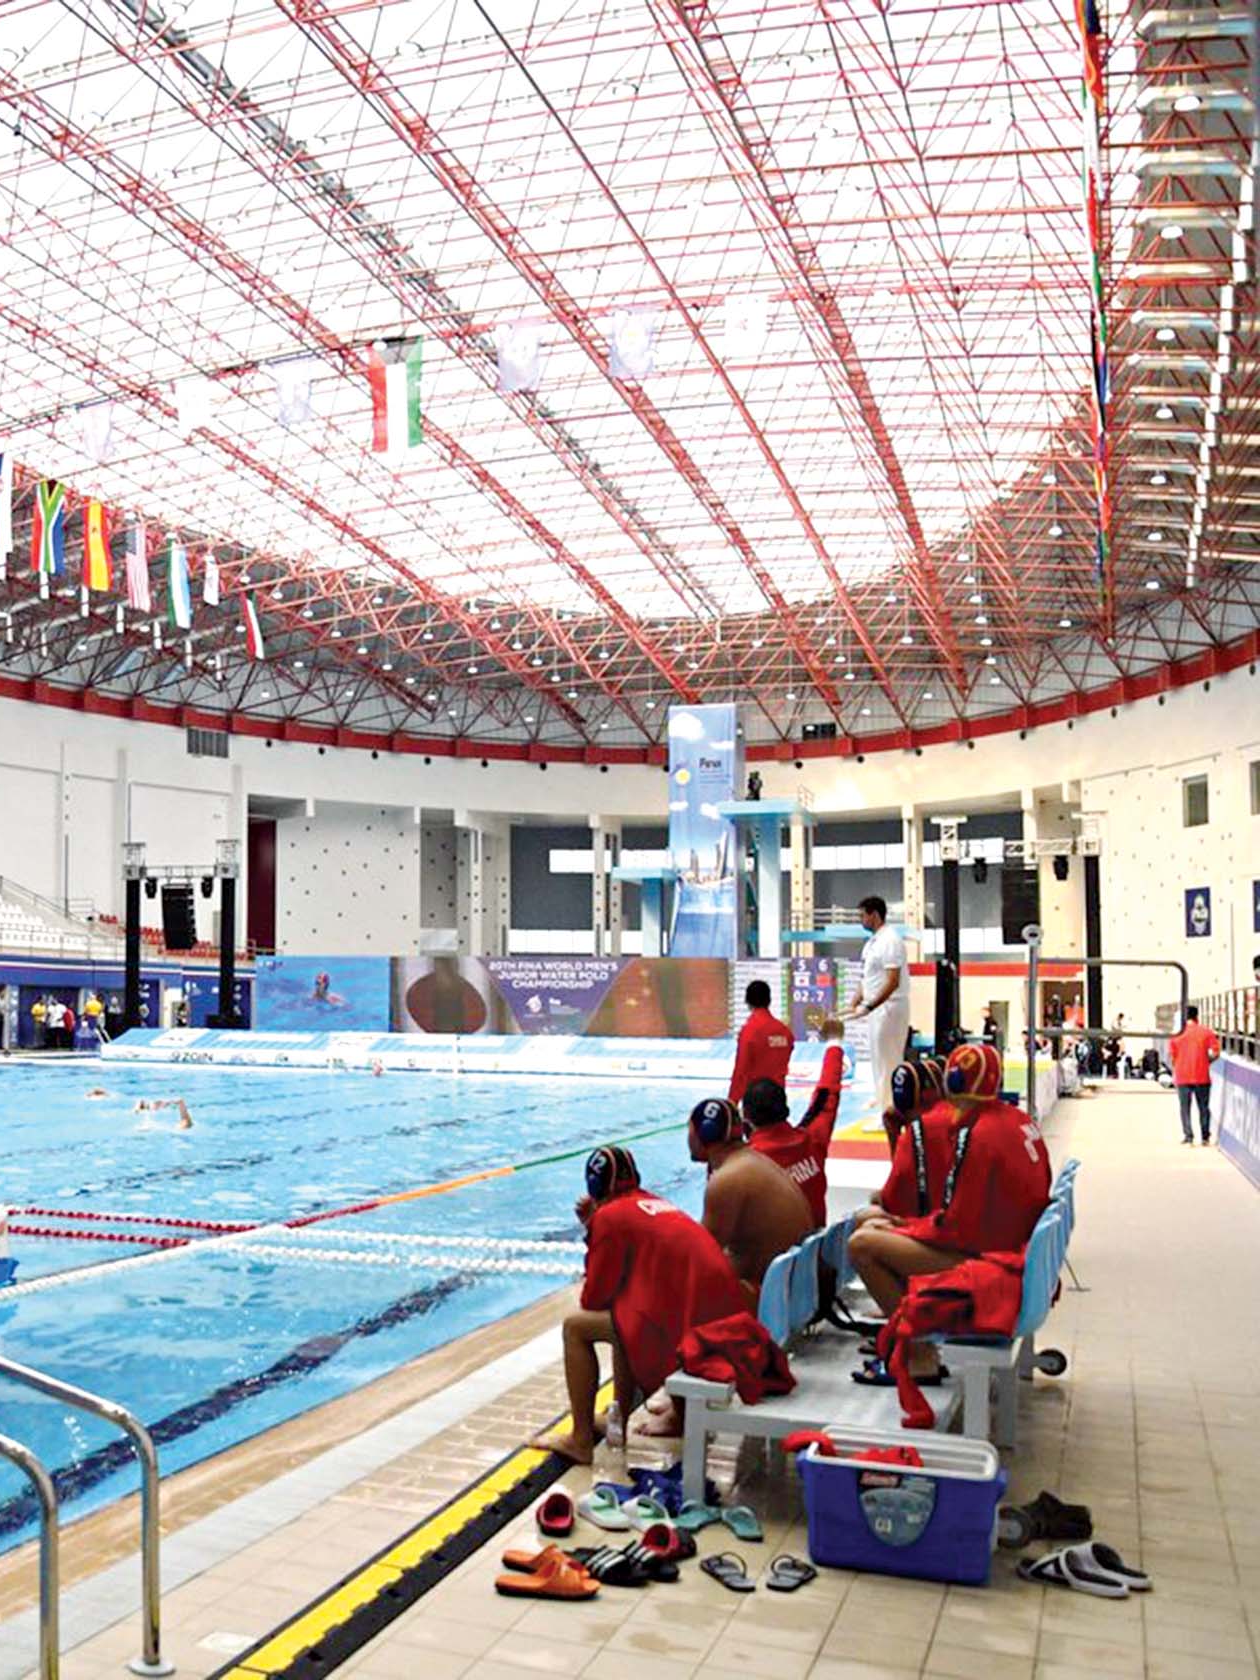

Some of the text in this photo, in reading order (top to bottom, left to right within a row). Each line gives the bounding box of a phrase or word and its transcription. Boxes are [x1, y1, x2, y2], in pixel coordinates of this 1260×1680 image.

[544, 961, 582, 971] WORLD
[798, 960, 806, 972] 5
[818, 960, 828, 972] 6
[498, 971, 608, 981] JUNIOR WATER POLO
[894, 1067, 907, 1086] 5
[703, 1101, 721, 1119] 6
[589, 1151, 607, 1174] 12
[787, 1155, 821, 1184] HINA
